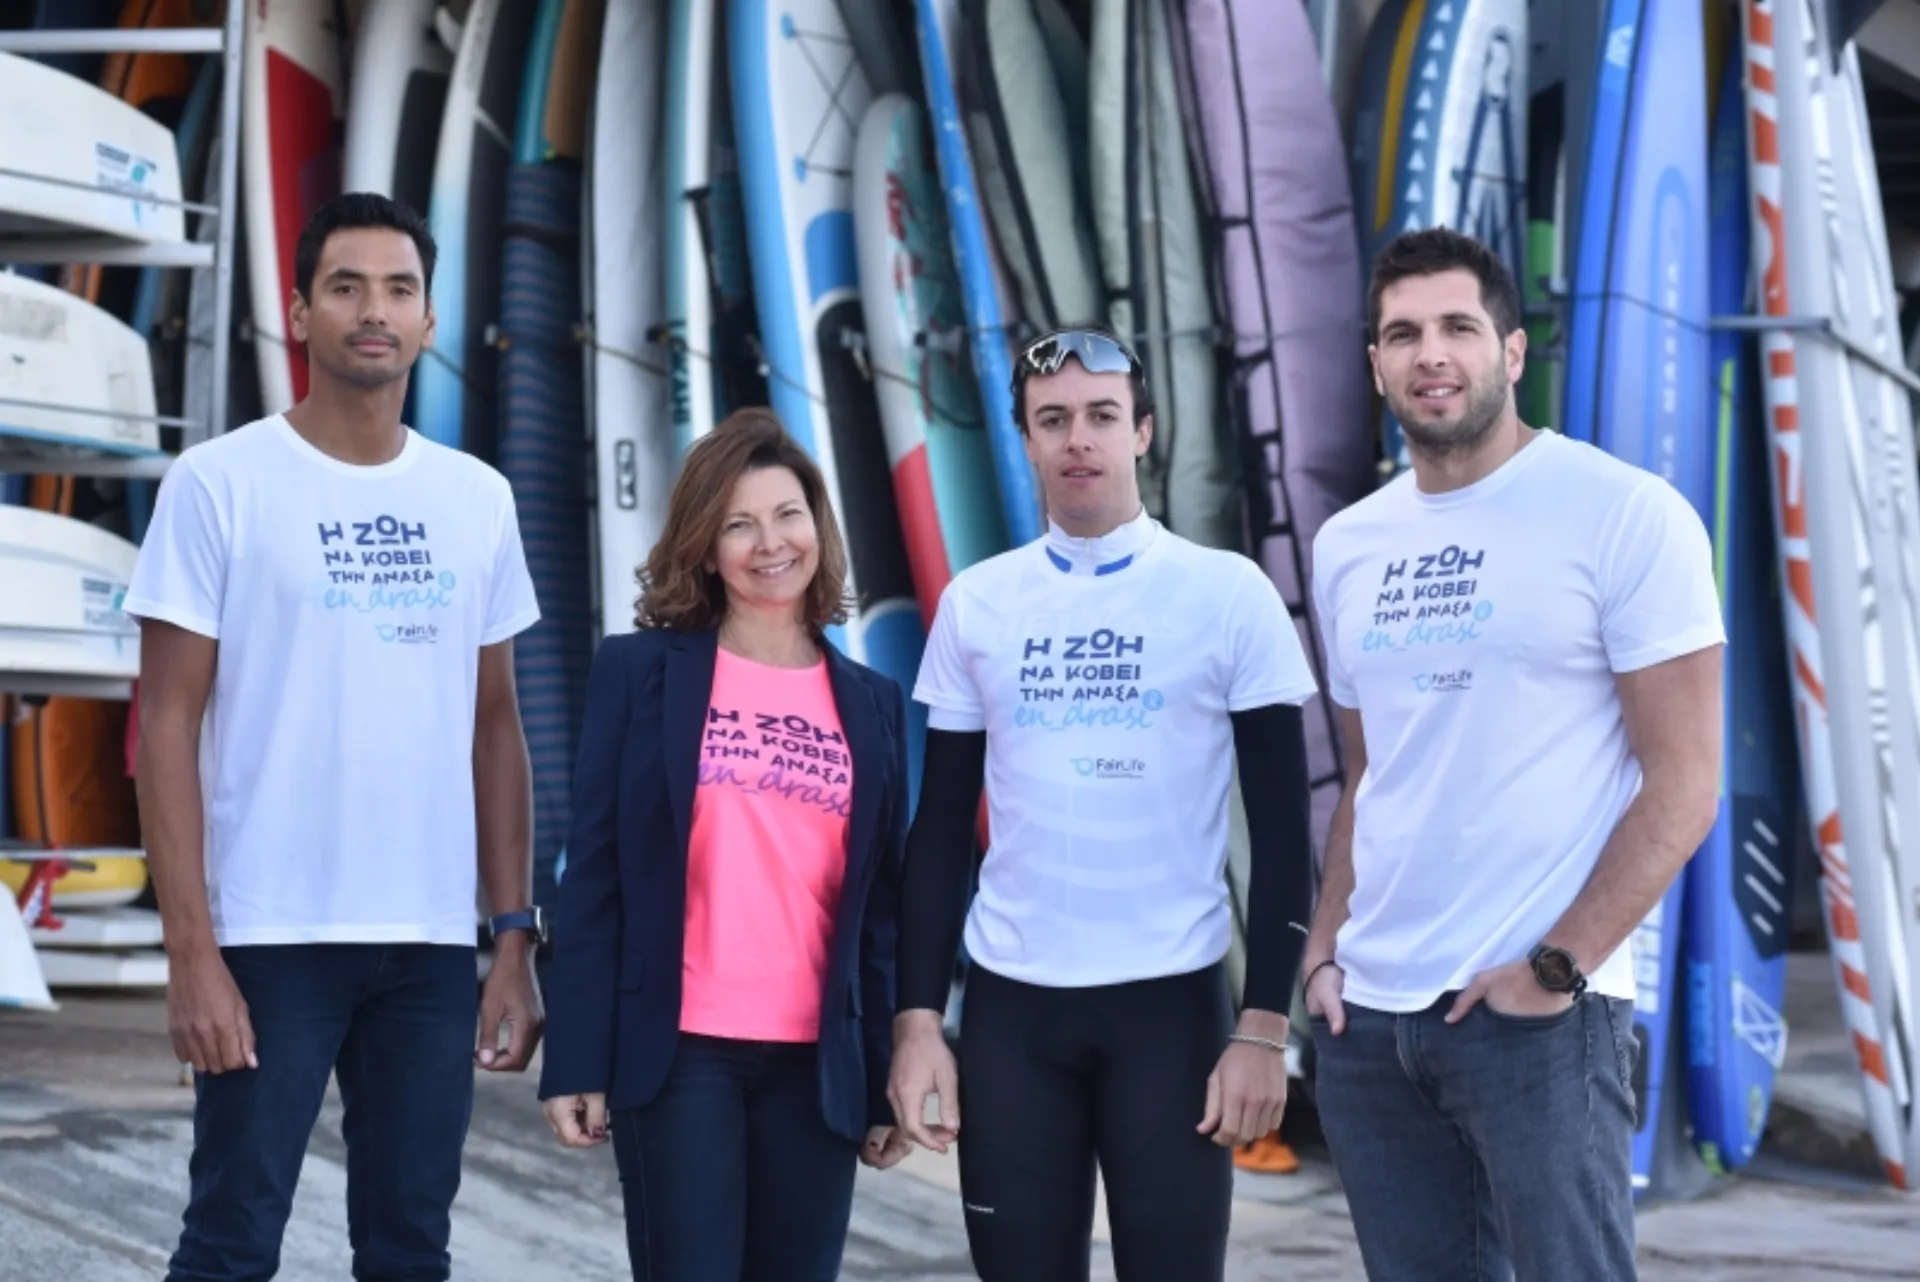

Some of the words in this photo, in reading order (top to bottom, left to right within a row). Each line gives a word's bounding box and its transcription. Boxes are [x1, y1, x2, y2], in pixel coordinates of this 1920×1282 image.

[318, 521, 344, 546] Η
[352, 514, 426, 546] ΖΩΗ
[323, 550, 354, 566] ΝΑ
[361, 549, 433, 567] ΚΟΒΕΙ
[1382, 558, 1408, 586] Η
[1413, 544, 1485, 579] ΖΩΗ
[328, 570, 365, 584] ΤΗΝ
[1376, 587, 1405, 607] ΝΑ
[1413, 579, 1477, 601] ΚΟΒΕΙ
[1373, 607, 1410, 626] ΤΗΝ
[1023, 637, 1052, 661] Η
[1063, 628, 1144, 660] ΖΩΗ
[1019, 665, 1054, 682] ΝΑ
[1065, 664, 1141, 681] ΚΟΒΕΙ
[1020, 687, 1064, 702] ΤΗΝ
[709, 707, 740, 723] Η
[755, 712, 844, 745] ΖΩΗ
[705, 745, 759, 759] ΤΗΝ
[707, 728, 747, 741] ΝΑ
[762, 733, 849, 767] ΚΟΒΕΙ
